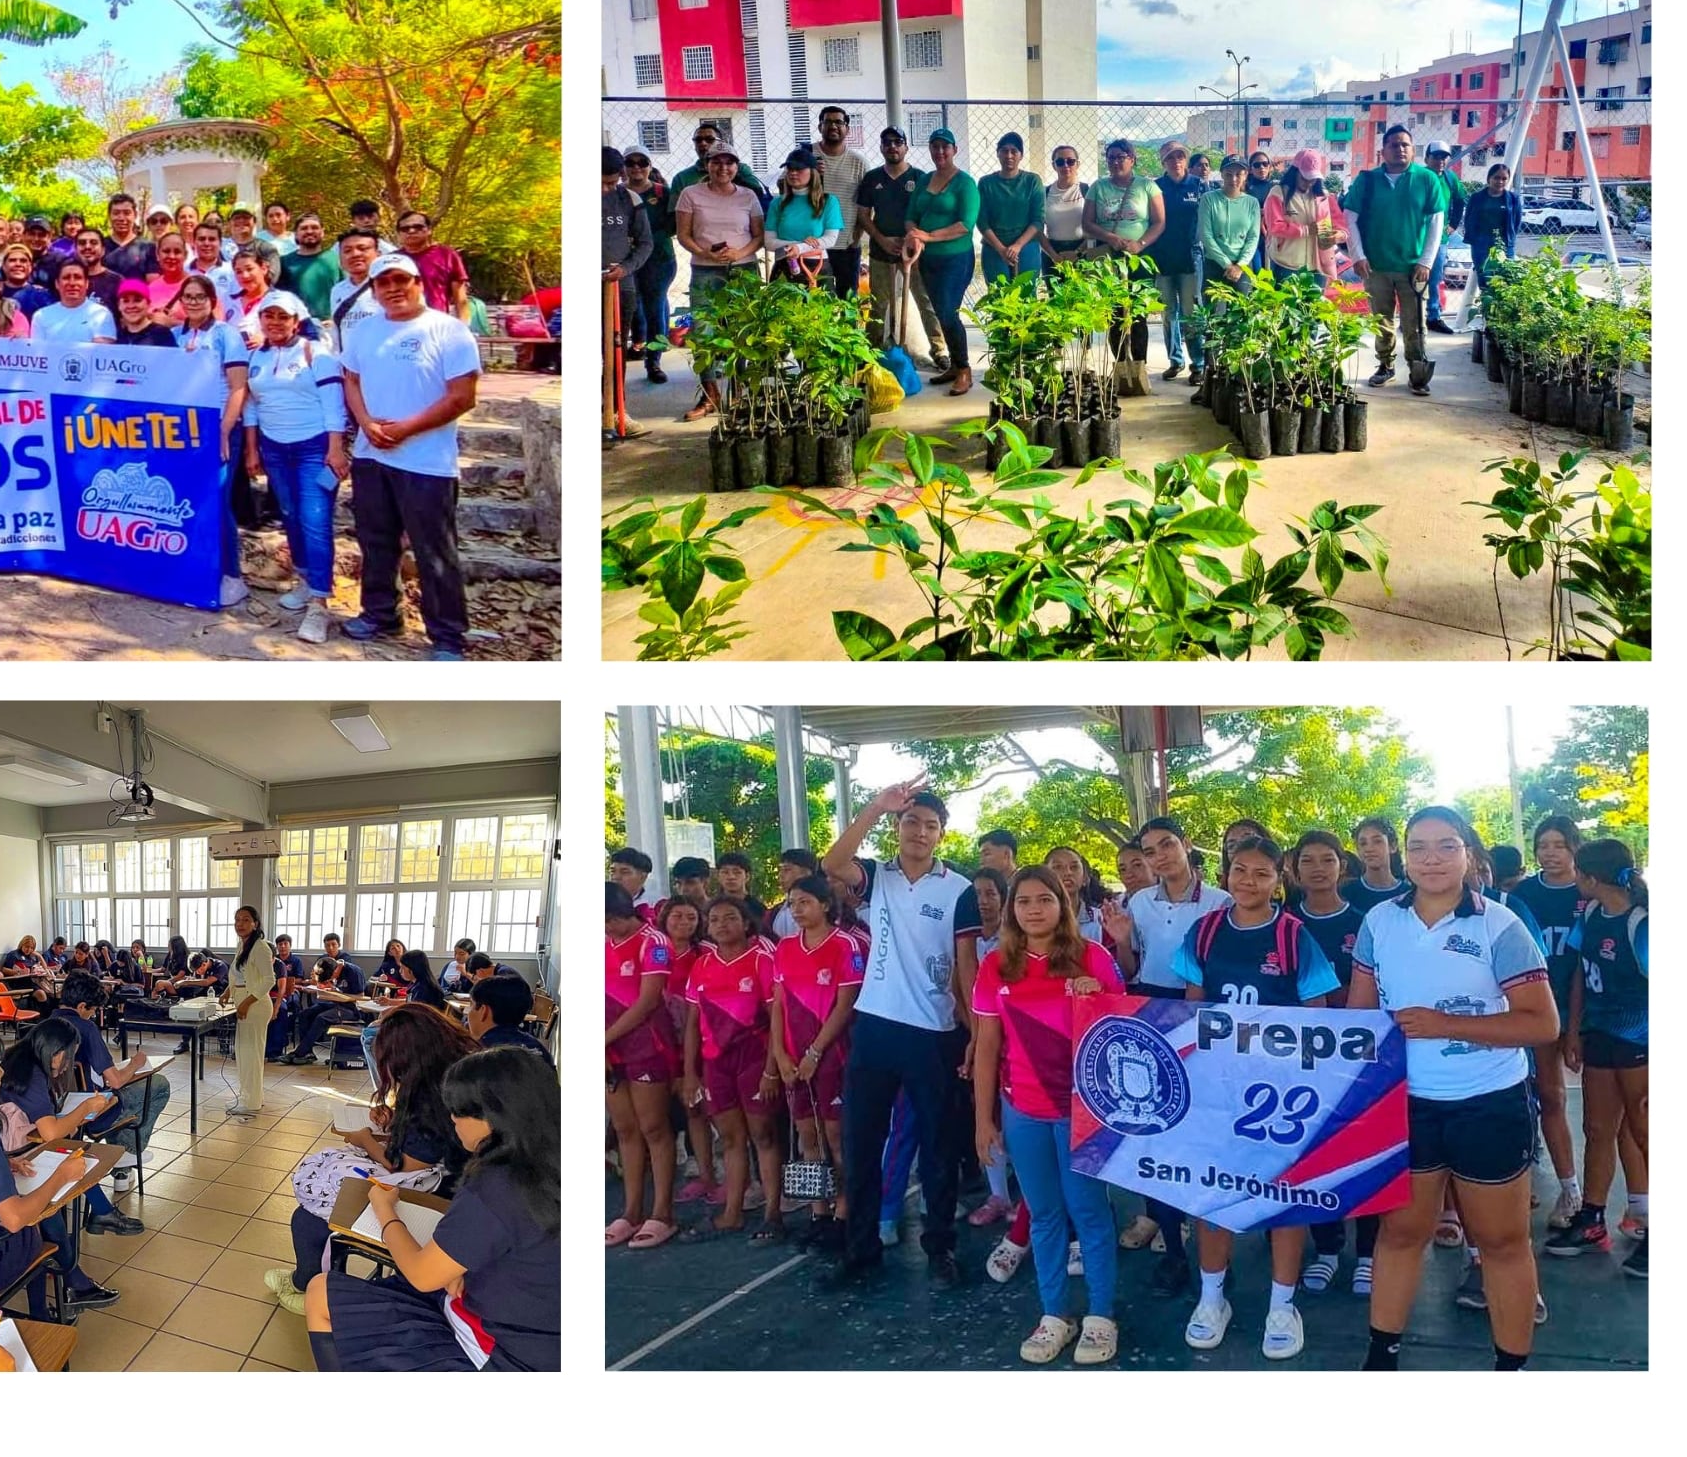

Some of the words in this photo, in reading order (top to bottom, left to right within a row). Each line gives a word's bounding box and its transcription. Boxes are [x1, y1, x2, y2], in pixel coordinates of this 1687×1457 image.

[95, 358, 147, 375] UAGro
[18, 398, 47, 422] DE
[64, 403, 200, 454] ¡ÚNETE!
[13, 511, 56, 533] paz
[78, 510, 185, 553] UAGro
[1197, 1008, 1378, 1073] Prepa
[1233, 1081, 1320, 1145] 23
[1136, 1155, 1192, 1186] San
[1200, 1161, 1340, 1212] Jerónimo
